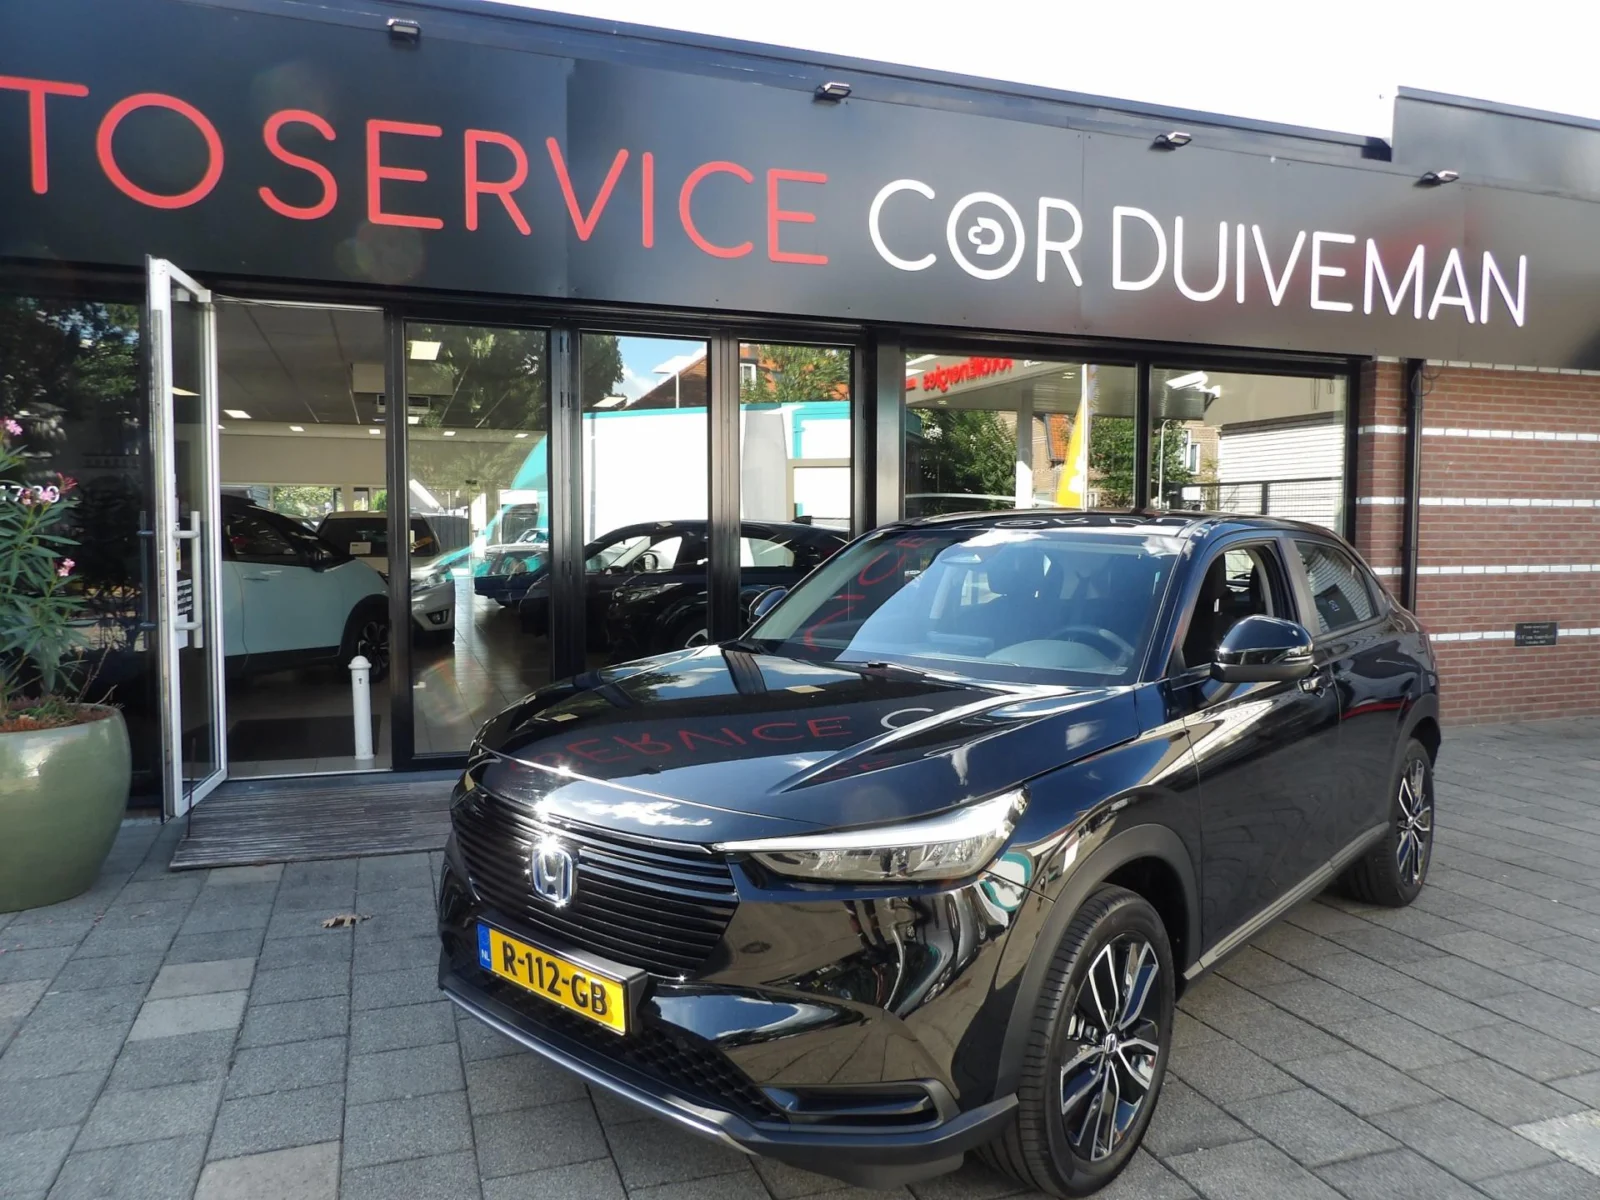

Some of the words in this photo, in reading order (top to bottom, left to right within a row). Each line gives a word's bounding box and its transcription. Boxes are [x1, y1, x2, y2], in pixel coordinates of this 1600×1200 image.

[868, 179, 1083, 287] COR
[1112, 206, 1528, 327] DUIVEMAN
[481, 949, 491, 962] NL
[502, 941, 607, 1016] R-112-GB
